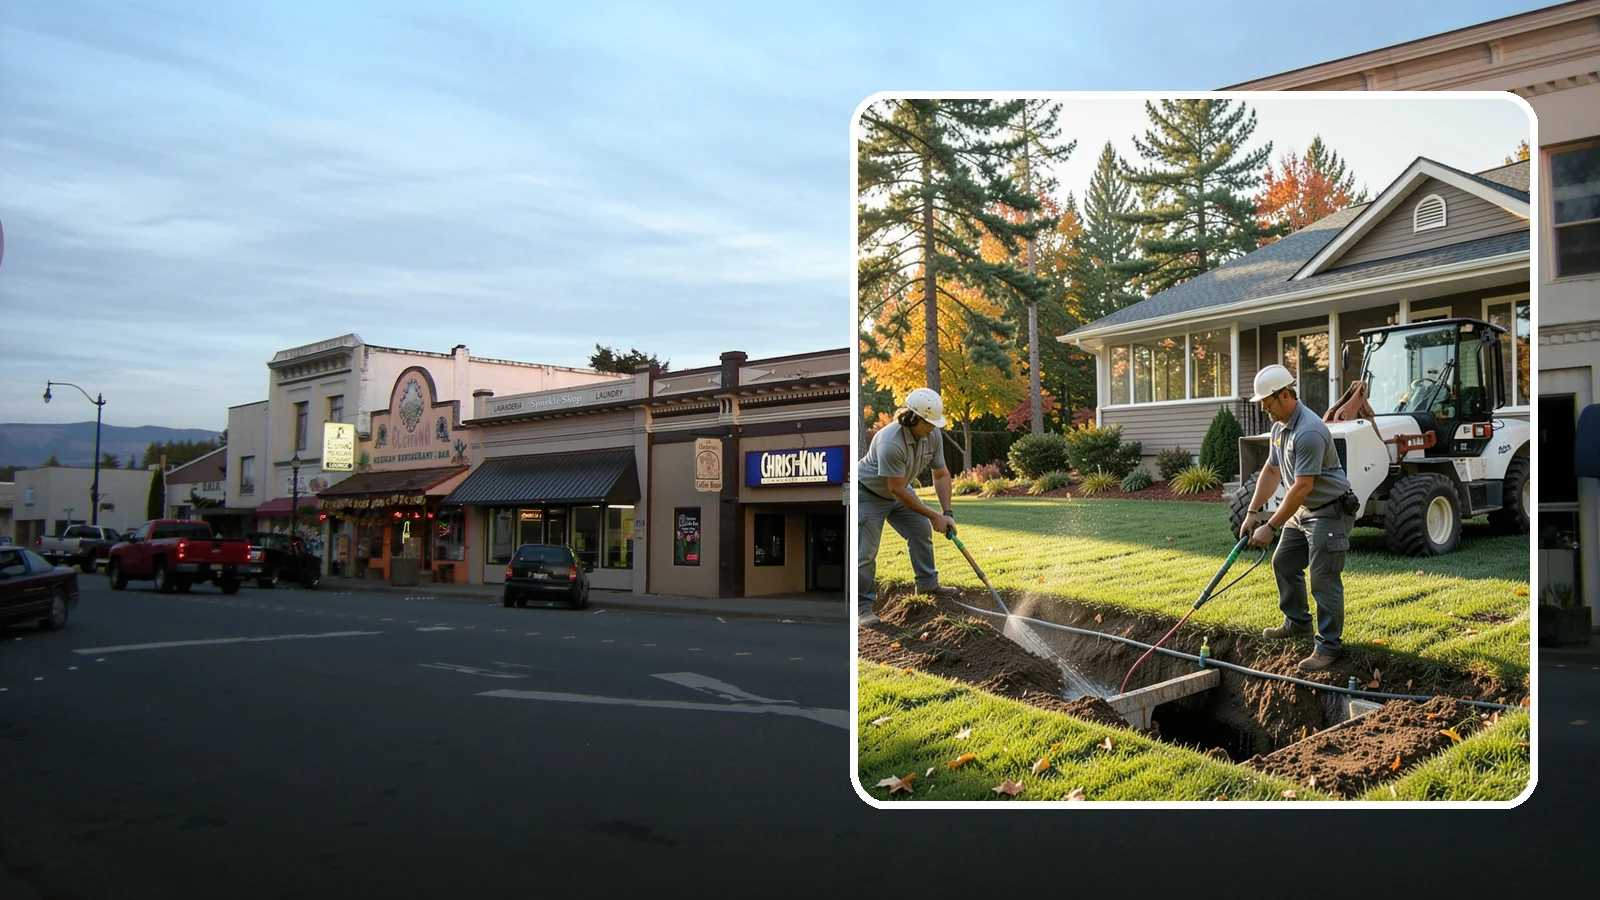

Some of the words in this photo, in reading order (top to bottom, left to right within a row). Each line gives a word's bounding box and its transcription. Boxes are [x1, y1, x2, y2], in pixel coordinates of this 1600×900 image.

[595, 389, 624, 400] LAUNDRY
[494, 402, 522, 413] LAVANDERIA
[530, 397, 562, 408] Sparkle
[562, 395, 582, 404] Shop
[392, 425, 402, 450] EL
[373, 455, 396, 464] MEXICAN
[397, 452, 434, 462] RESTAURANT
[438, 450, 450, 459] BAR
[696, 480, 709, 488] Coffee
[710, 480, 722, 488] House
